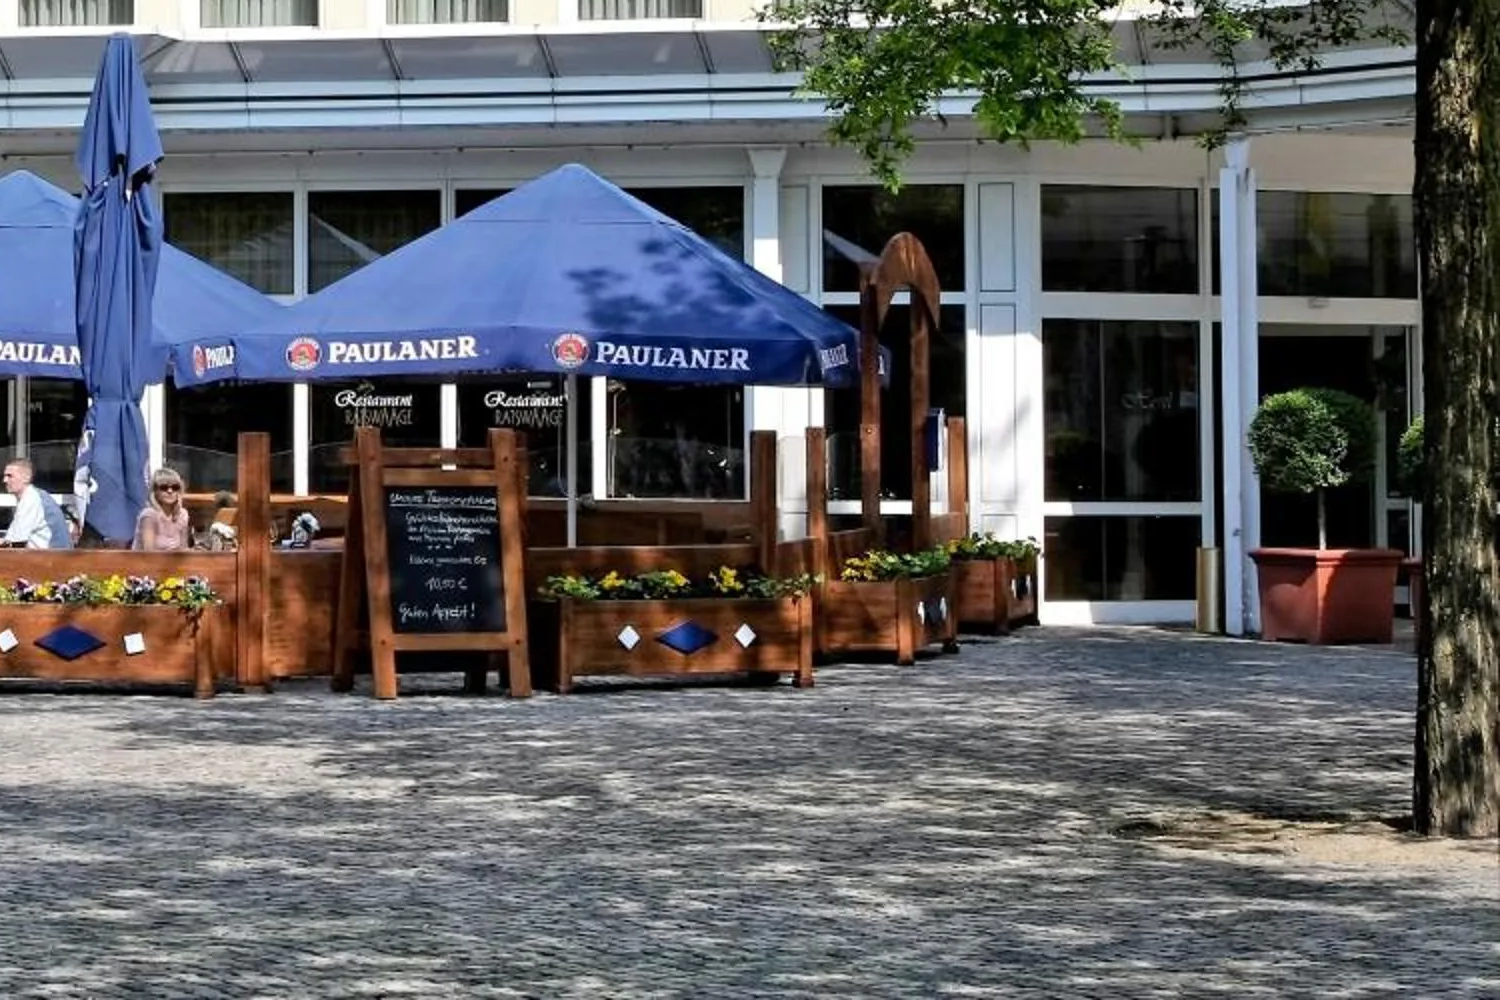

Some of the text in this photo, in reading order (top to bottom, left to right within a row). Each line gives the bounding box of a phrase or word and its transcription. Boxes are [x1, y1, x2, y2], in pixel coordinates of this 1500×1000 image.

[327, 335, 479, 364] PAULANER
[595, 341, 751, 371] PAULANER
[334, 390, 413, 408] Restaurant
